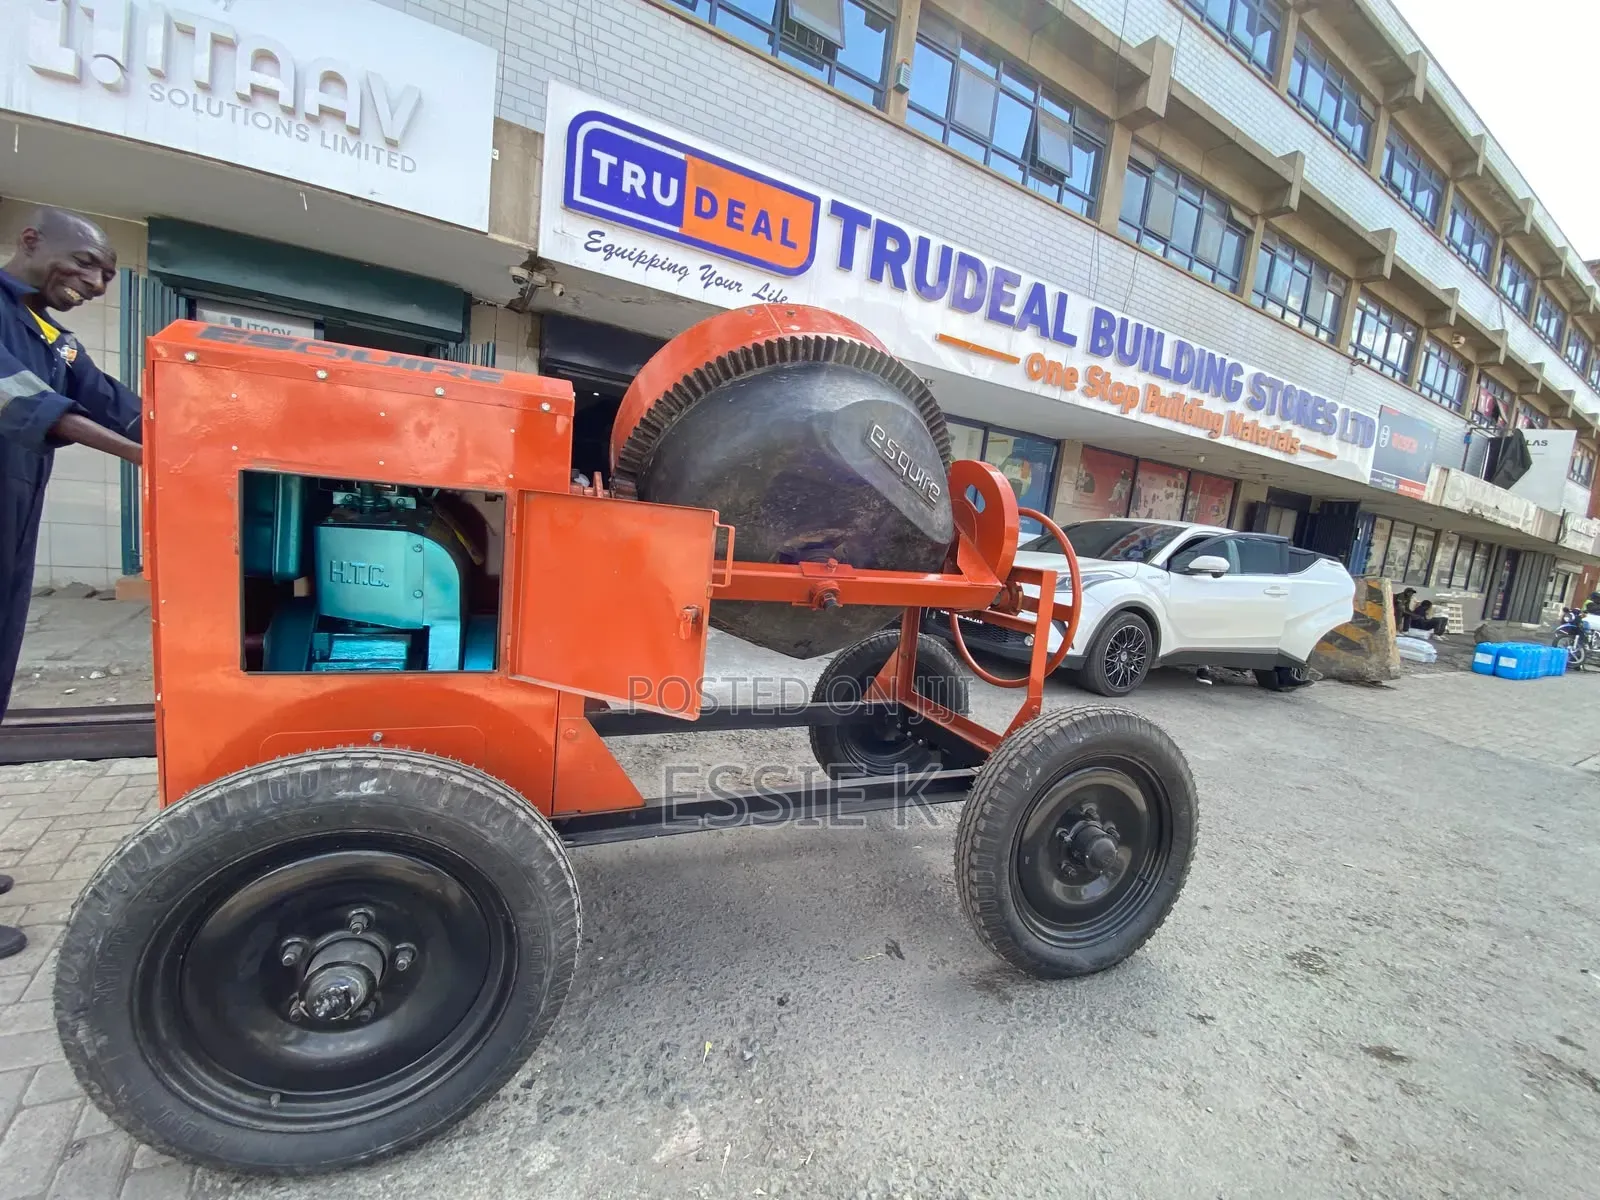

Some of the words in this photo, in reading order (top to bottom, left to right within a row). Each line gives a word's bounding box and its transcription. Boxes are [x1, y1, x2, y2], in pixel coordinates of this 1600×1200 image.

[150, 82, 310, 143] SOLUTIONS
[320, 130, 417, 174] LIMITED
[592, 149, 679, 207] TRU
[694, 186, 798, 250] DEAL
[584, 230, 689, 282] Equipping
[699, 264, 744, 293] Your
[196, 325, 505, 384] ESQUIRE
[827, 199, 1078, 348] TRUDEAL
[1087, 306, 1245, 403] BUILDING
[1247, 372, 1339, 436] STORES
[1338, 407, 1377, 449] LTD
[1082, 364, 1140, 415] Stop
[1141, 383, 1225, 440] Building
[1225, 410, 1301, 456] Materials
[870, 424, 941, 504] esquire
[329, 559, 390, 588] H.T.C.
